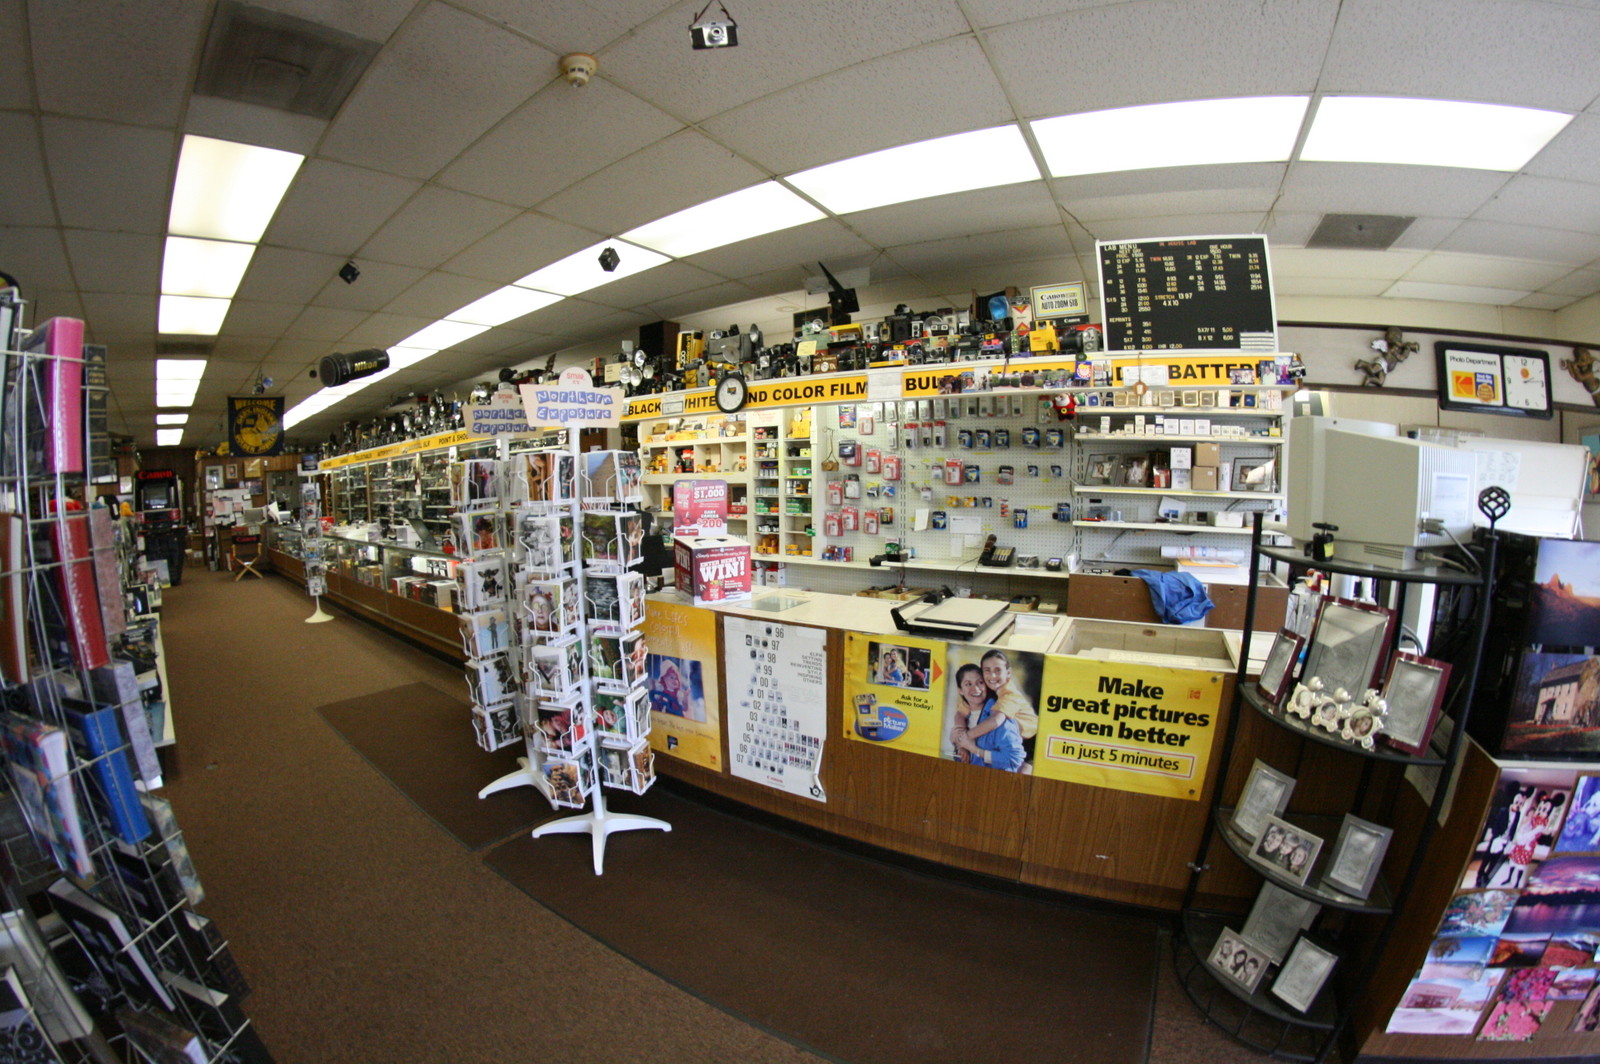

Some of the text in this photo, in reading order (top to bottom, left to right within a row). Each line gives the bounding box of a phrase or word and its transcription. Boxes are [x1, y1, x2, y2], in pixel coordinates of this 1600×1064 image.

[1055, 300, 1068, 309] ZOOM
[354, 361, 378, 372] Nikon
[1466, 357, 1496, 366] Department
[537, 391, 613, 404] Northern
[628, 402, 661, 416] BLACK
[745, 390, 768, 404] ND
[773, 385, 824, 401] COLOR
[234, 400, 277, 411] WELCOME
[537, 407, 611, 422] Exposure
[439, 436, 451, 445] POINT
[138, 470, 173, 479] Canon
[694, 489, 724, 499] $1,000
[696, 518, 723, 528] $200
[700, 560, 746, 582] WIN!
[775, 627, 784, 638] 96
[772, 640, 779, 651] 97
[768, 652, 776, 663] 98
[764, 665, 772, 676] 99
[760, 677, 768, 687] 00
[1098, 676, 1164, 700] Make
[757, 689, 764, 699] 01
[753, 700, 761, 710] 02
[750, 711, 757, 721] 03
[1047, 695, 1210, 727] great pictures
[746, 722, 754, 732] 04
[1060, 718, 1190, 747] even better
[743, 733, 751, 743] 05
[740, 744, 747, 753] 06
[736, 754, 744, 764] 07
[1062, 741, 1179, 770] in just 5 minutes
